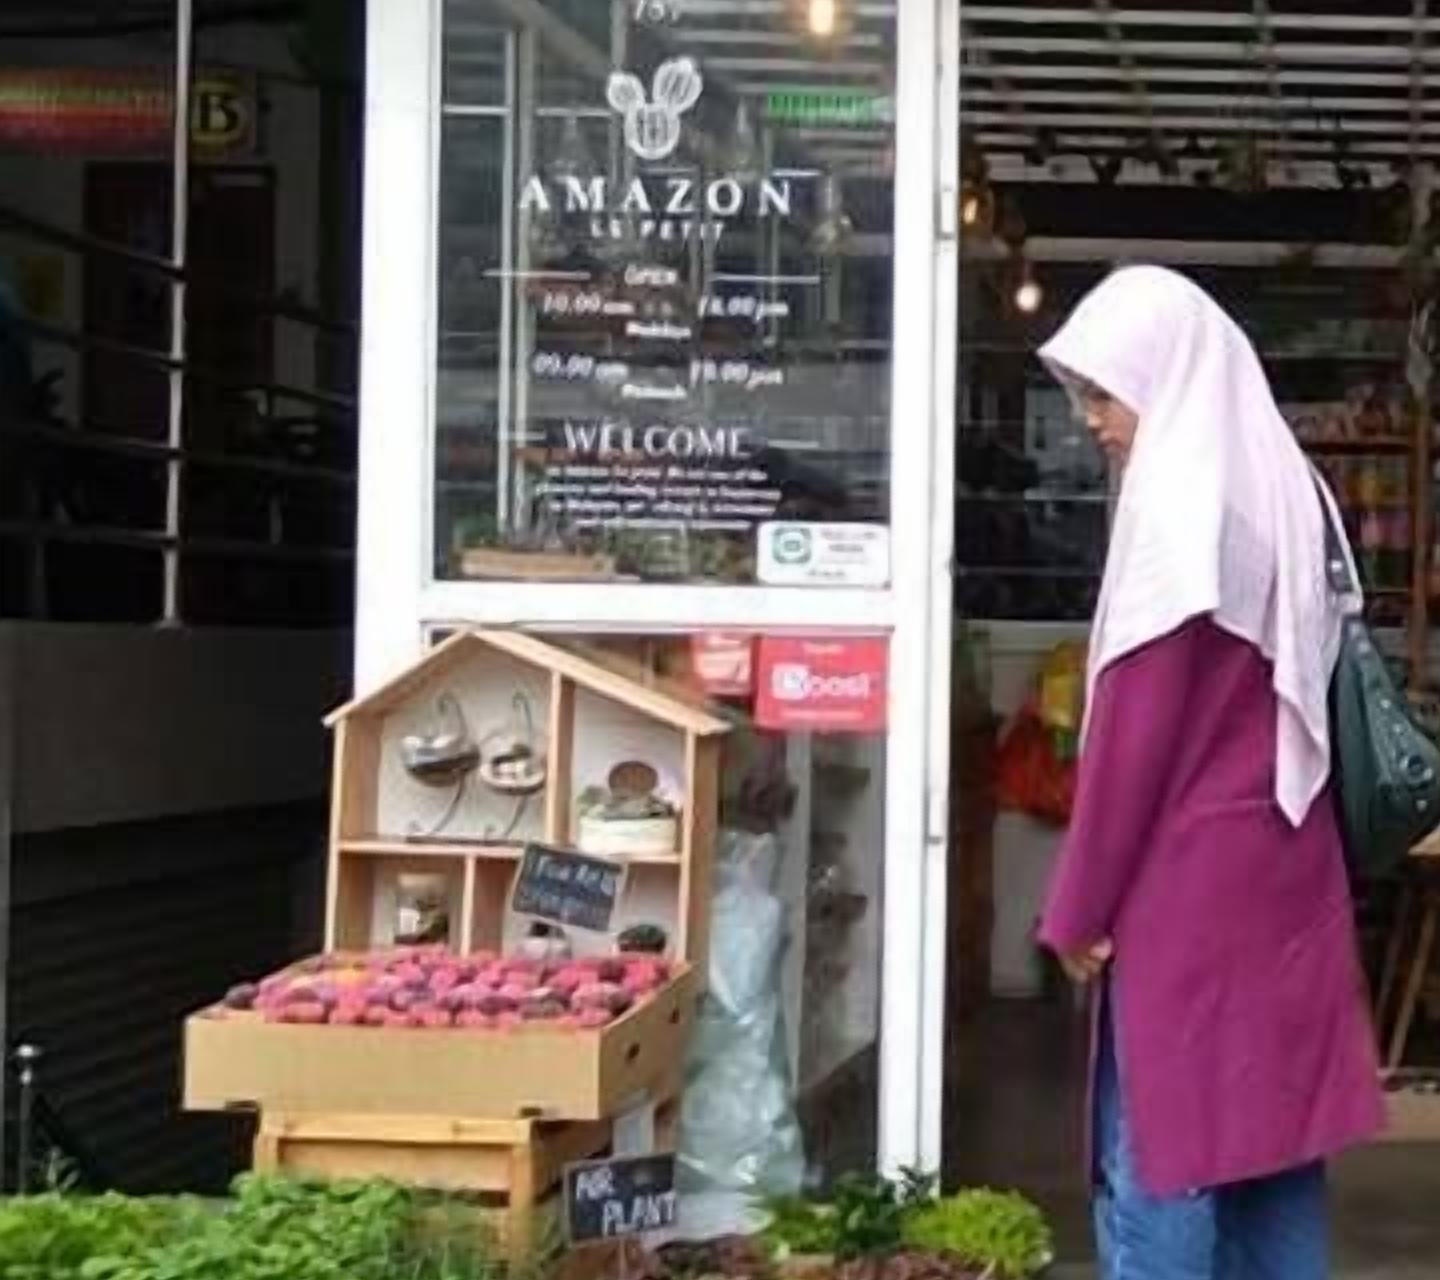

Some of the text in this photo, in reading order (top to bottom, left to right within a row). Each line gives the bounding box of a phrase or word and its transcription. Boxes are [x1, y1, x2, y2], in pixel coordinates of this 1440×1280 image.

[519, 176, 791, 216] AMAZON
[562, 418, 754, 458] WELCOME
[602, 1190, 677, 1236] PLANT
